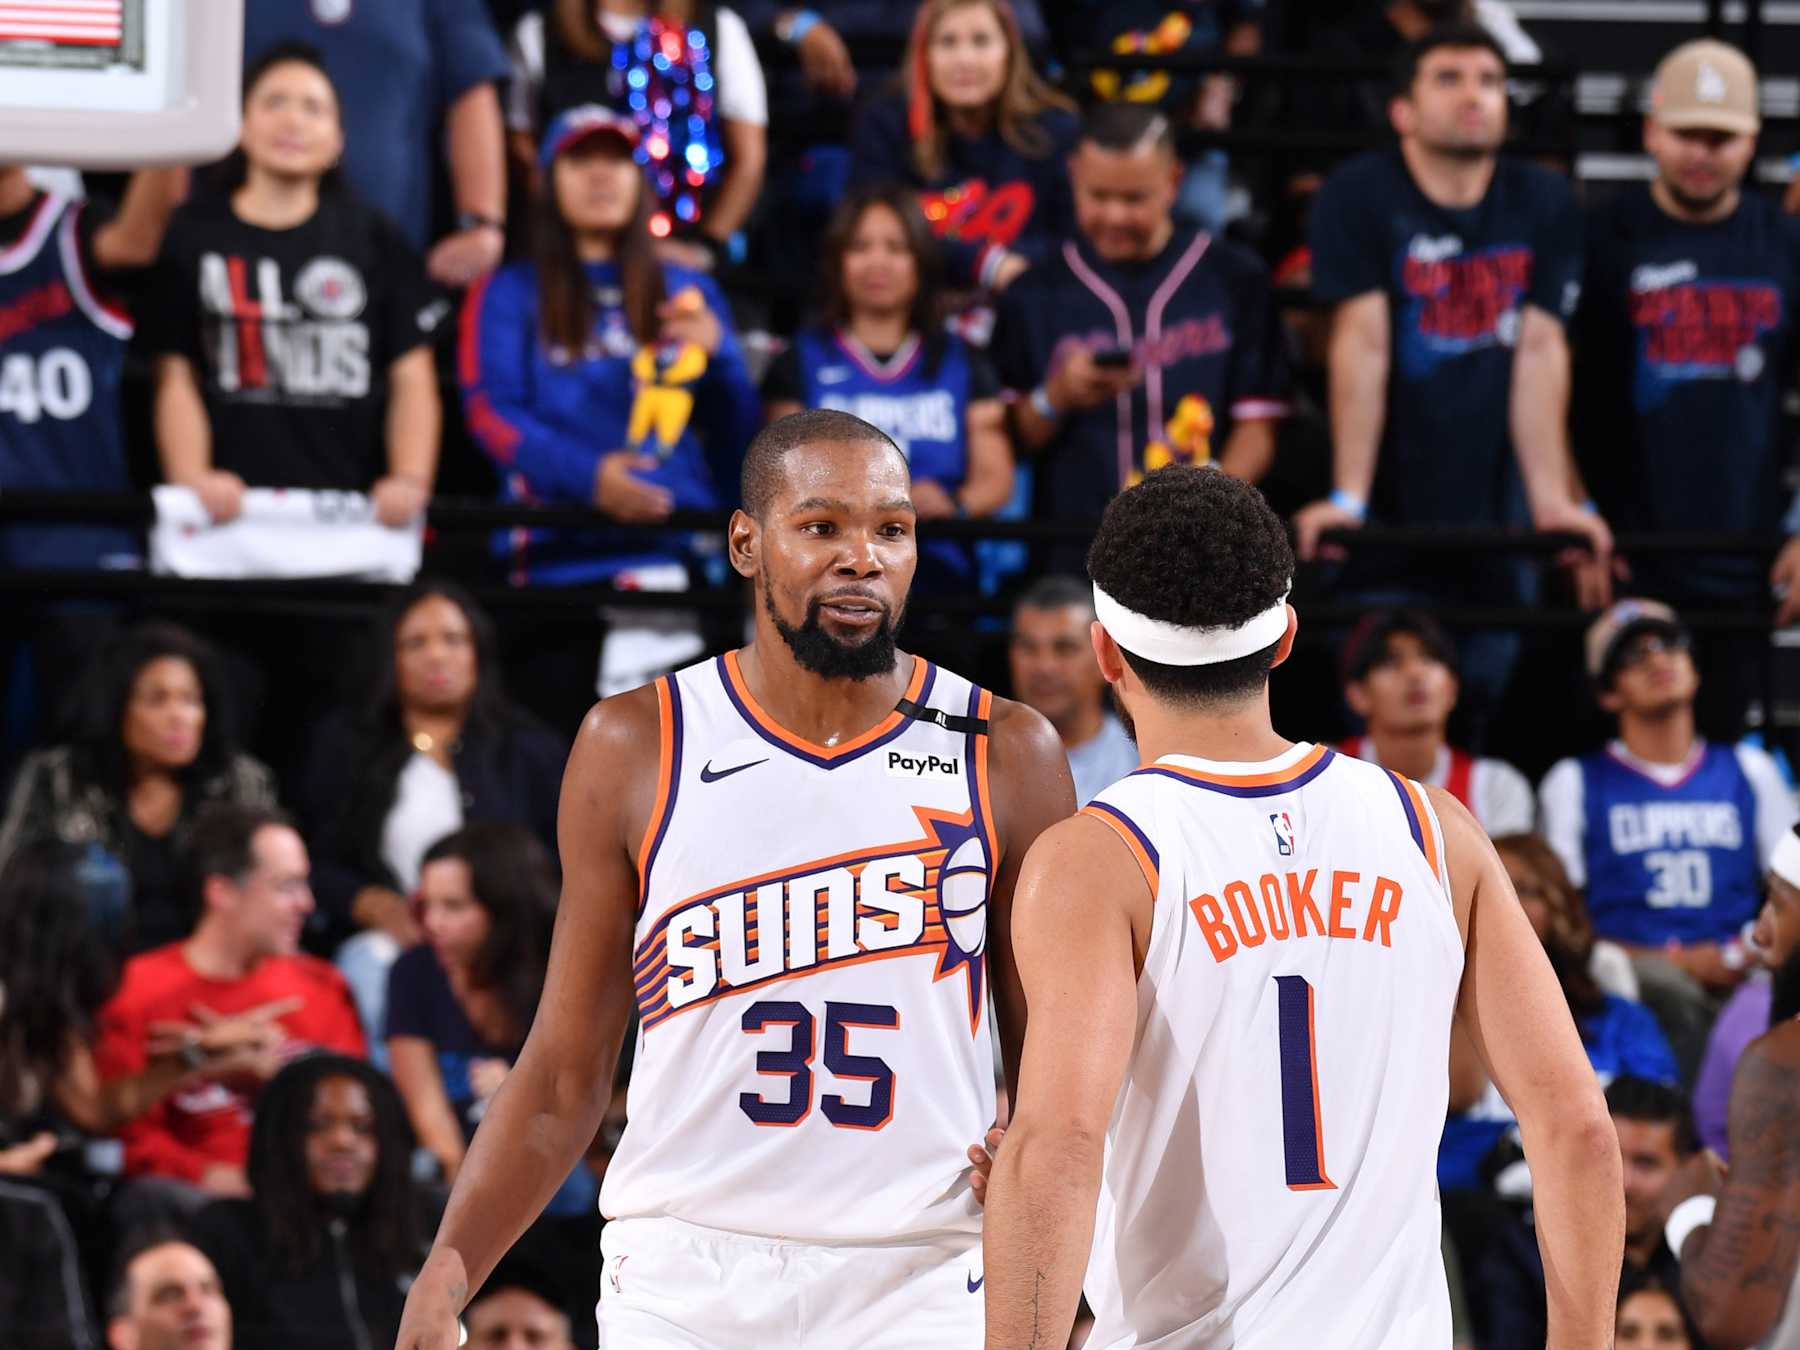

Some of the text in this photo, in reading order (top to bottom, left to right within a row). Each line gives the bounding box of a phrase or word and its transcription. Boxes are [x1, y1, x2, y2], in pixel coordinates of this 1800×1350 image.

[0, 349, 93, 423] 40
[934, 711, 948, 728] AL
[888, 751, 959, 776] PayPal
[1609, 802, 1743, 855] CLIPPERS
[1189, 868, 1403, 963] BOOKER
[1644, 850, 1713, 909] 30
[666, 854, 926, 1009] SUNS
[739, 1000, 900, 1131] 35
[1272, 975, 1338, 1191] 1
